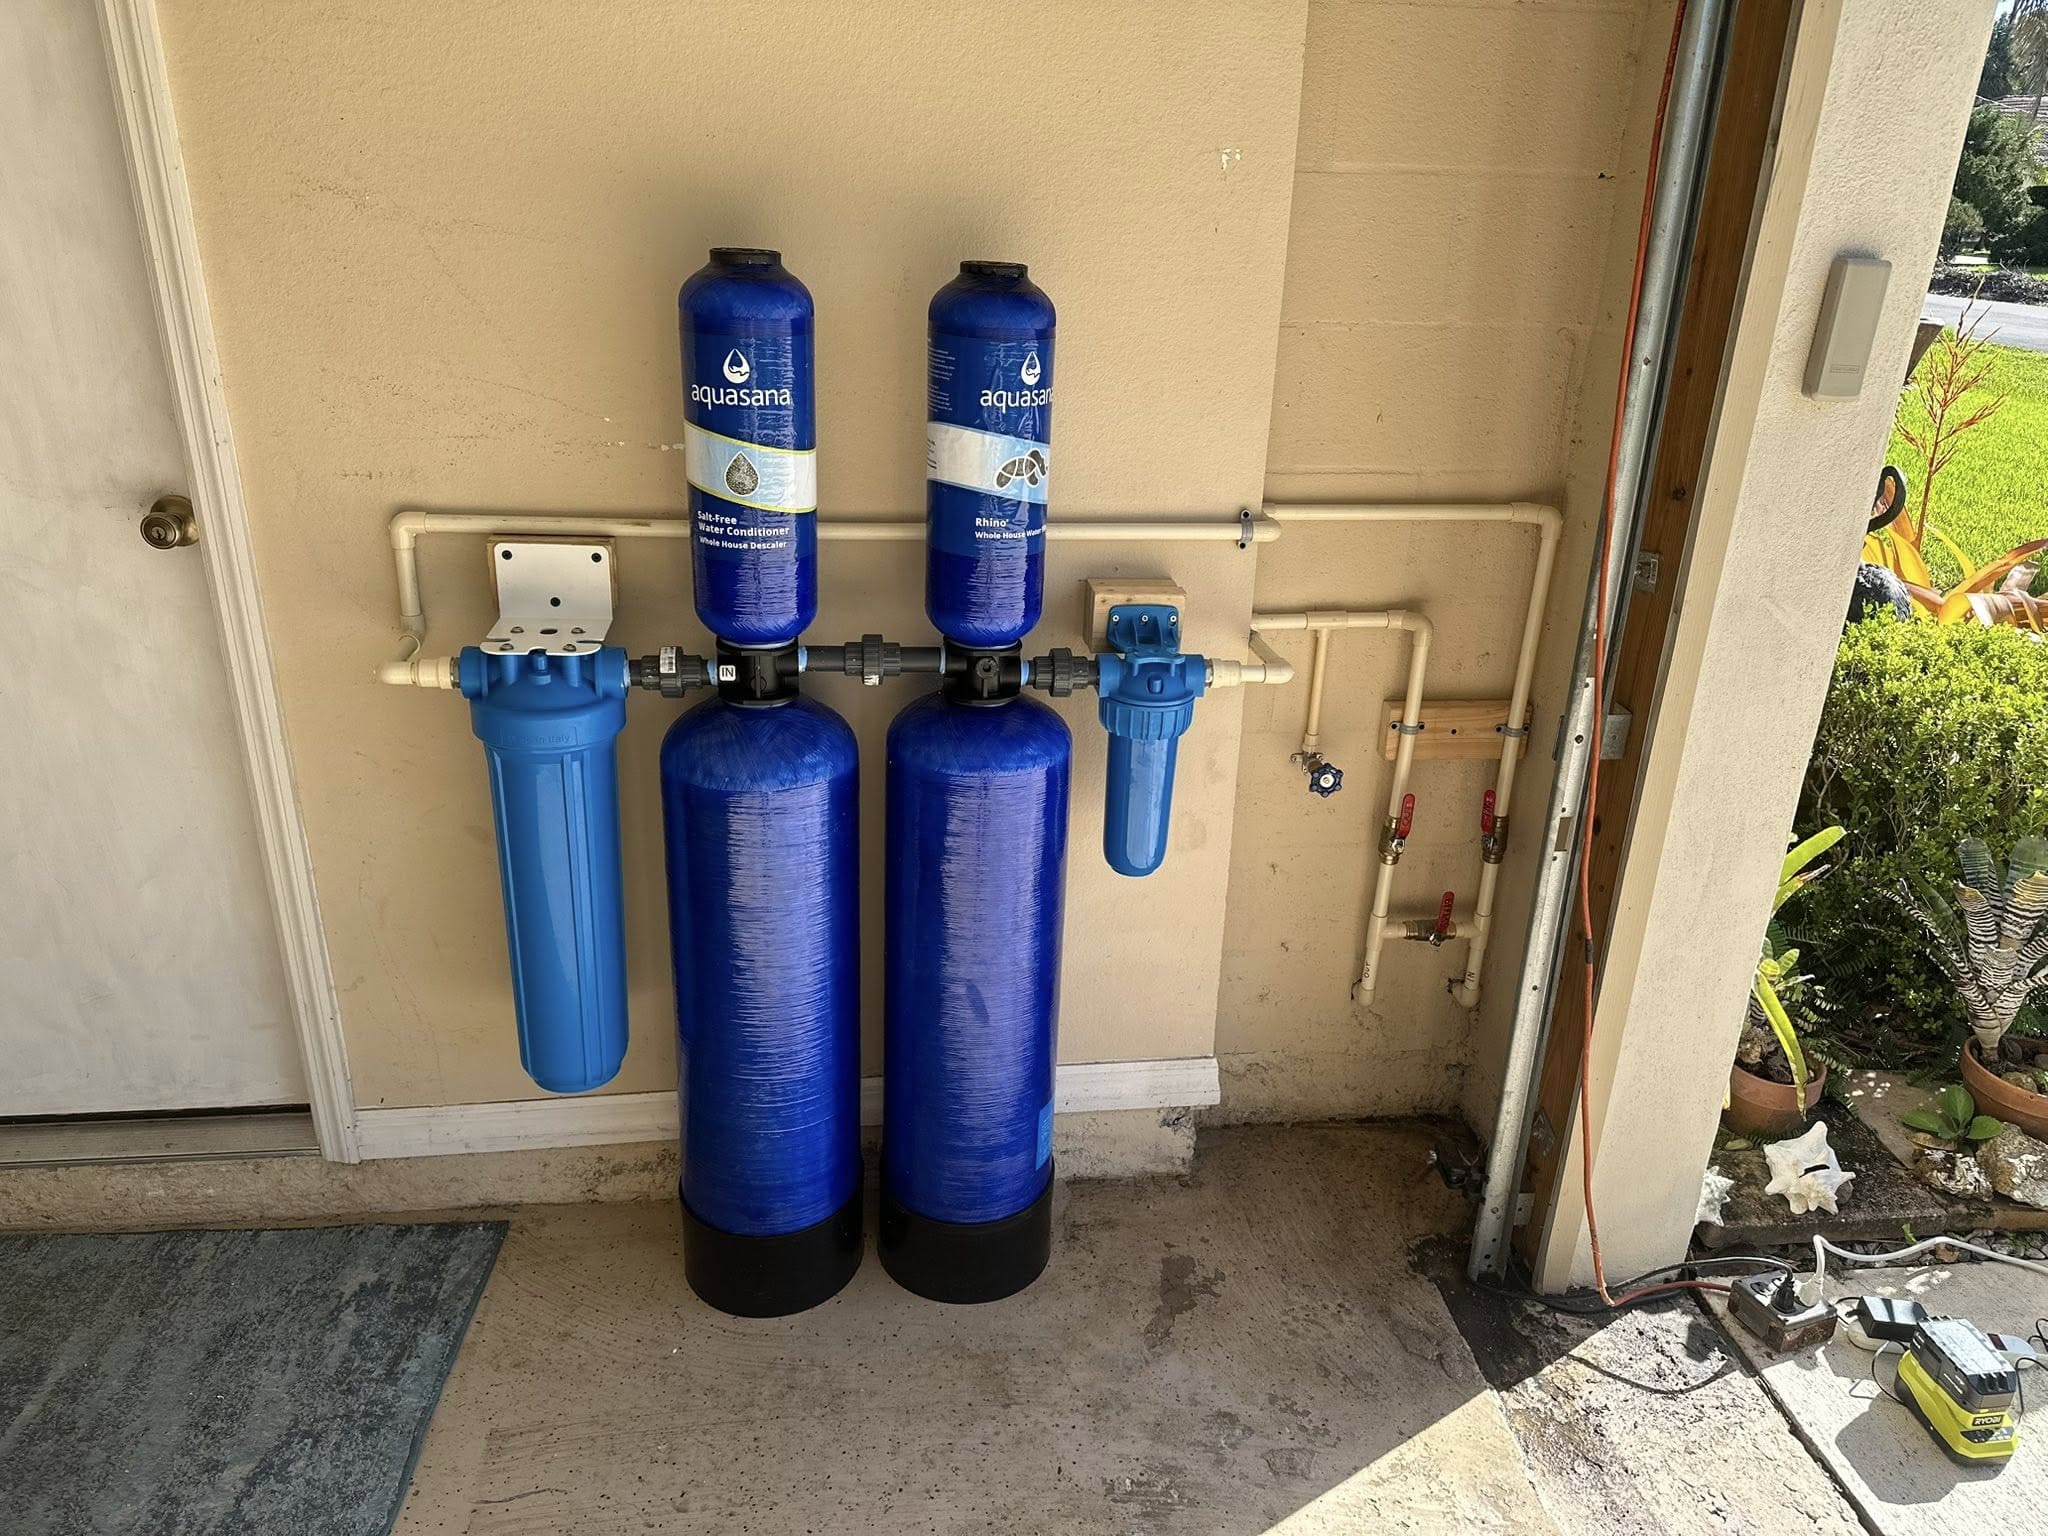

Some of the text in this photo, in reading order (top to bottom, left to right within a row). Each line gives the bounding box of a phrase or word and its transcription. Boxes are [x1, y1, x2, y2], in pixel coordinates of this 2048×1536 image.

[692, 384, 791, 410] aquasana
[697, 510, 737, 525] Salt-Free
[698, 521, 790, 537] Water Conditioner
[974, 531, 1001, 539] Whole
[699, 535, 787, 549] Whole House Descaler
[722, 667, 733, 677] IN
[1363, 960, 1371, 978] OUT
[1974, 1416, 2002, 1425] RYOBI
